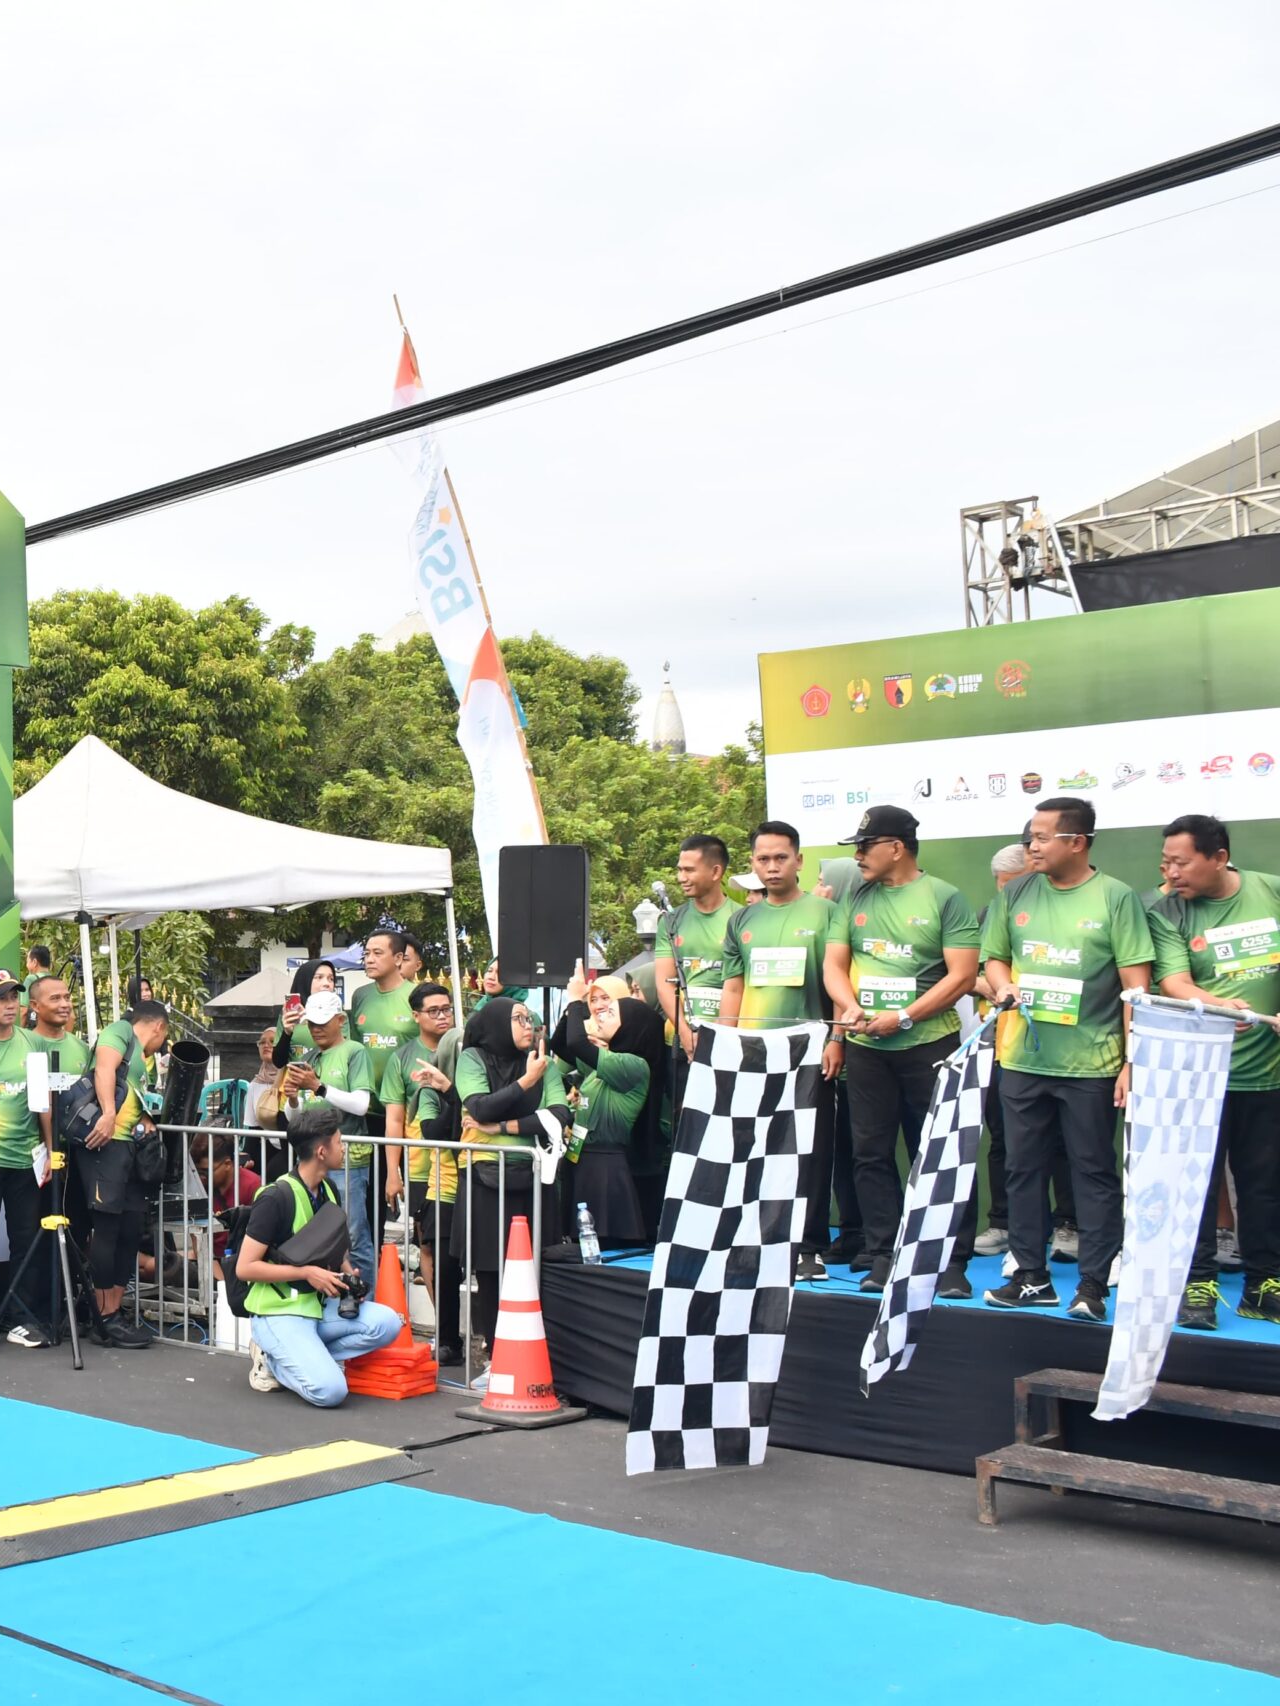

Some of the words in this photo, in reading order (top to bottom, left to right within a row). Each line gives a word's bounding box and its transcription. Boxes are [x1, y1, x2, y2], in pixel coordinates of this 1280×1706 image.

[816, 794, 835, 806] BRI
[847, 791, 869, 804] BSI
[1241, 934, 1272, 948] 6255
[880, 991, 908, 1001] 6304
[1042, 992, 1072, 1003] 6239
